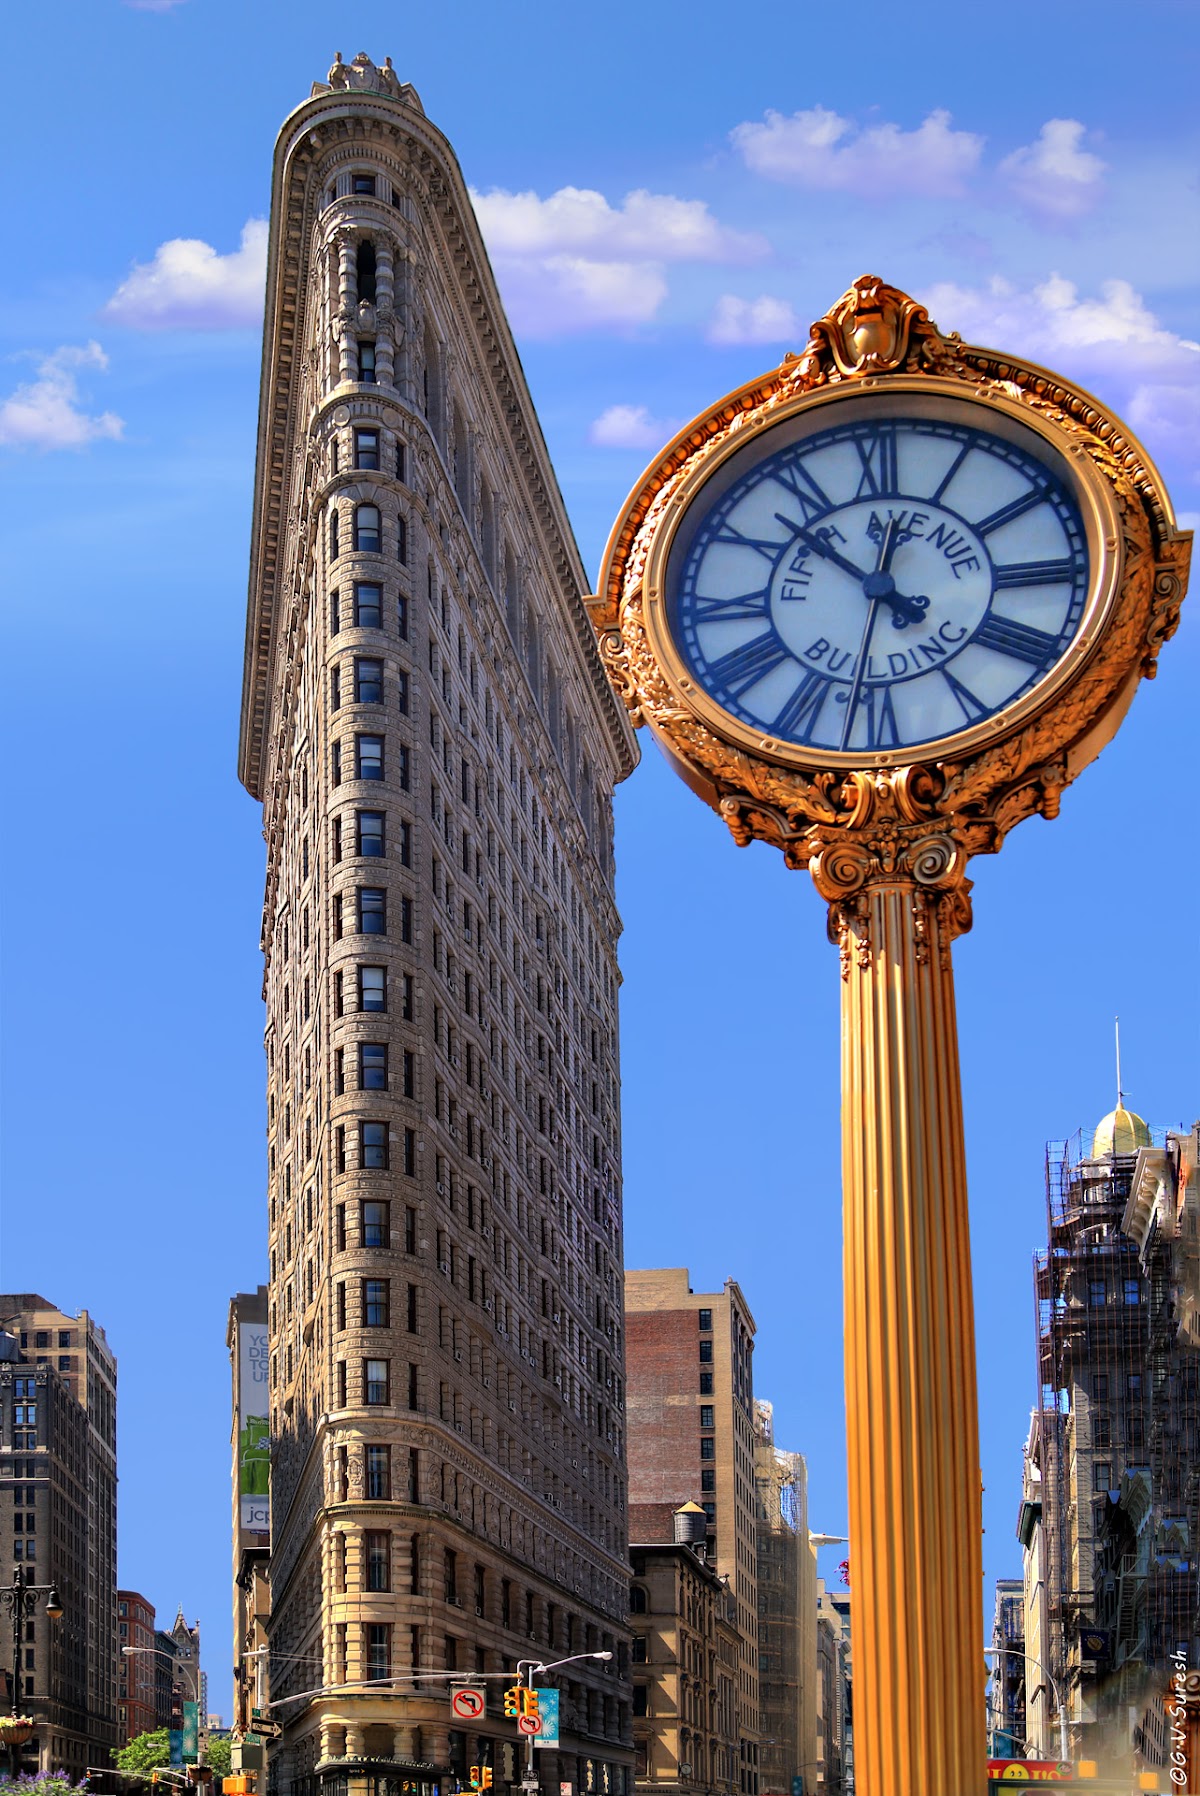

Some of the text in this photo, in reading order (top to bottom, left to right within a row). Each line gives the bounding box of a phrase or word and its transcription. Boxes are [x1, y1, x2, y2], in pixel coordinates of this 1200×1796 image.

[780, 509, 980, 602] FIFH AVENUE
[803, 620, 968, 679] BUILDING
